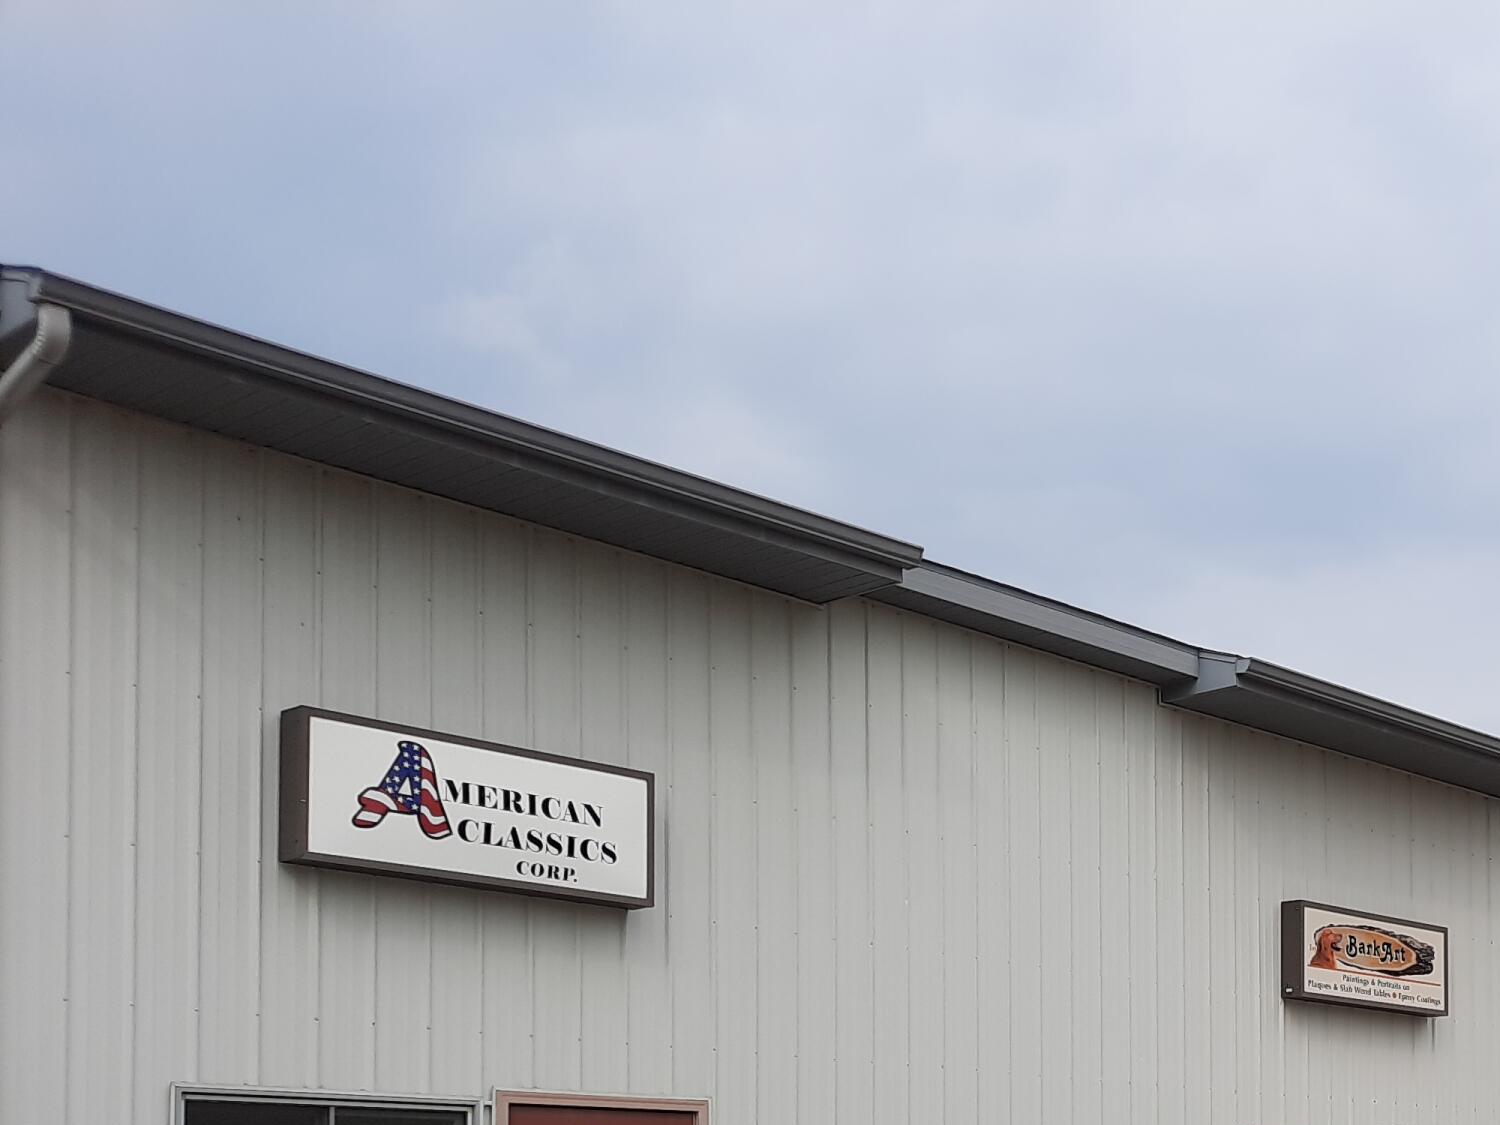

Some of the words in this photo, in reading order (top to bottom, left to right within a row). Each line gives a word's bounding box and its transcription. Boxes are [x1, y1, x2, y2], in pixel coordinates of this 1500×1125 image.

[352, 740, 604, 840] AMERICAN
[457, 818, 618, 865] CLASSICS
[515, 860, 579, 883] CORP.
[1308, 979, 1332, 991] Plaques
[1354, 986, 1372, 996] Wood
[1342, 974, 1370, 987] Paintings
[1377, 979, 1402, 990] Portraits
